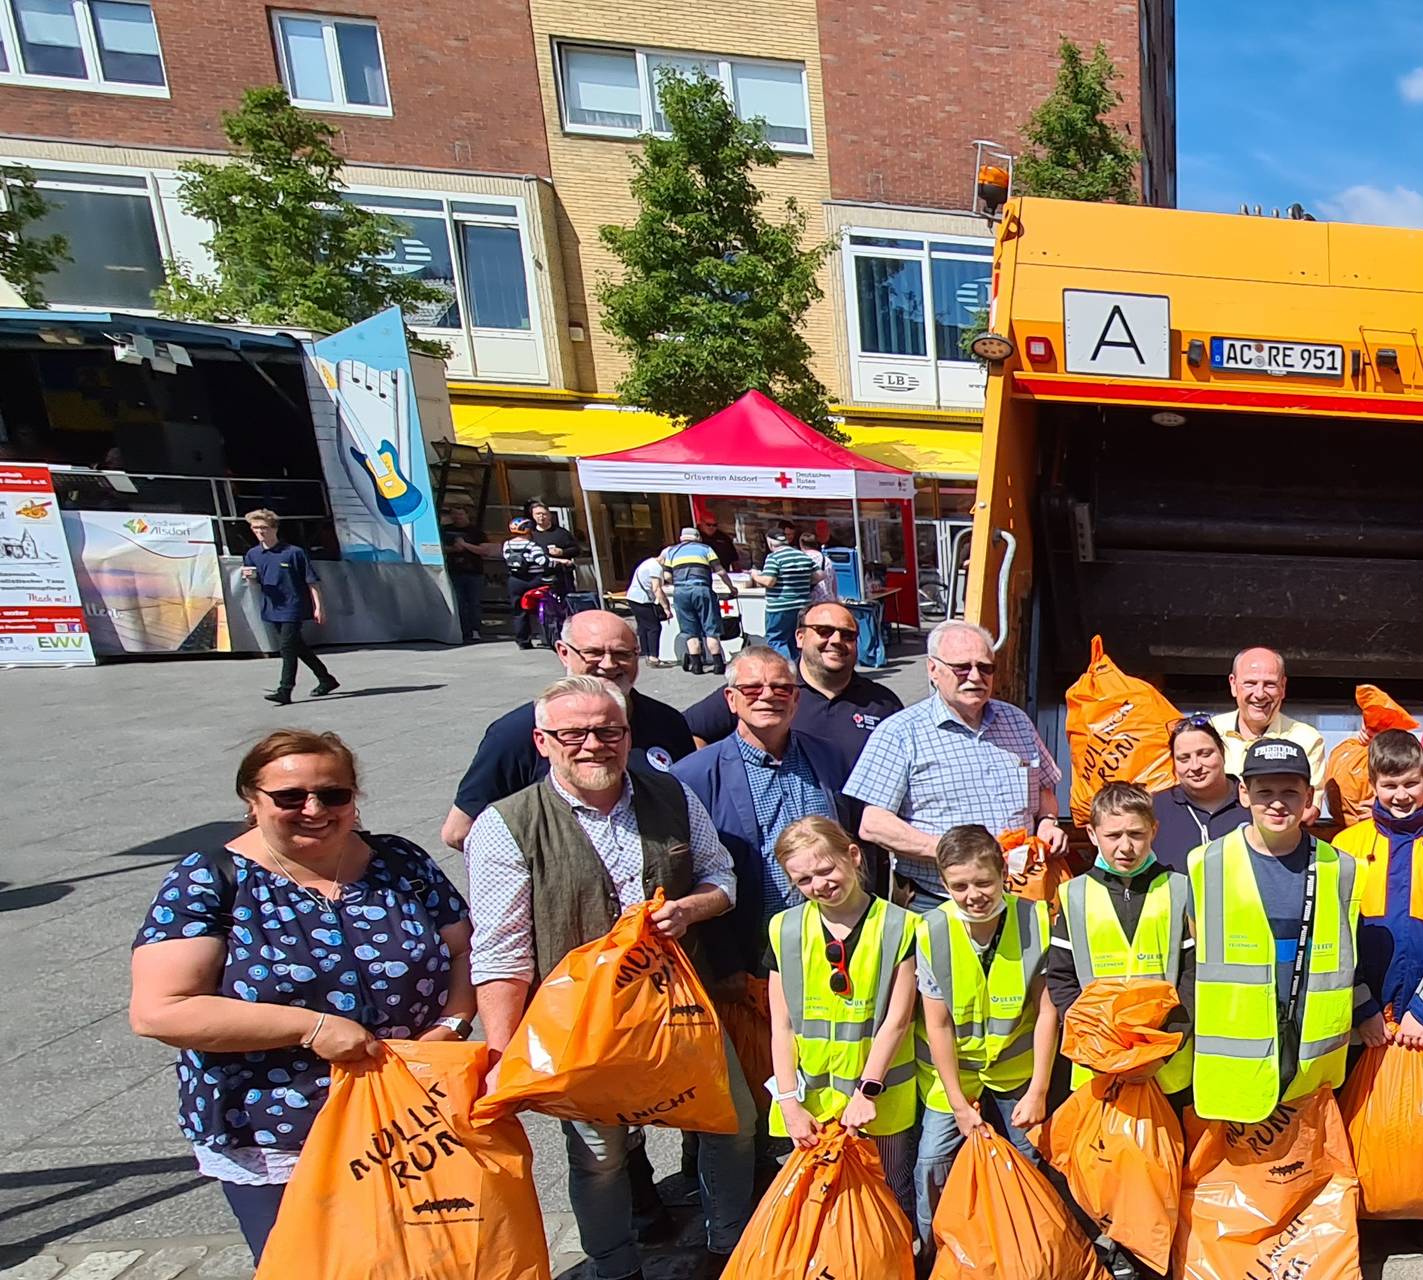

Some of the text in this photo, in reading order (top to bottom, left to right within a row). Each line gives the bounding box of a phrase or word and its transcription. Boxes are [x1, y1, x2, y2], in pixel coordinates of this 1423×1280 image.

[1089, 304, 1146, 365] A
[1225, 343, 1339, 372] AC RE 951
[887, 375, 906, 386] LB
[683, 472, 758, 483] Ortsverein Alsdorf
[150, 526, 191, 536] Alsdorf
[37, 636, 84, 649] EWV
